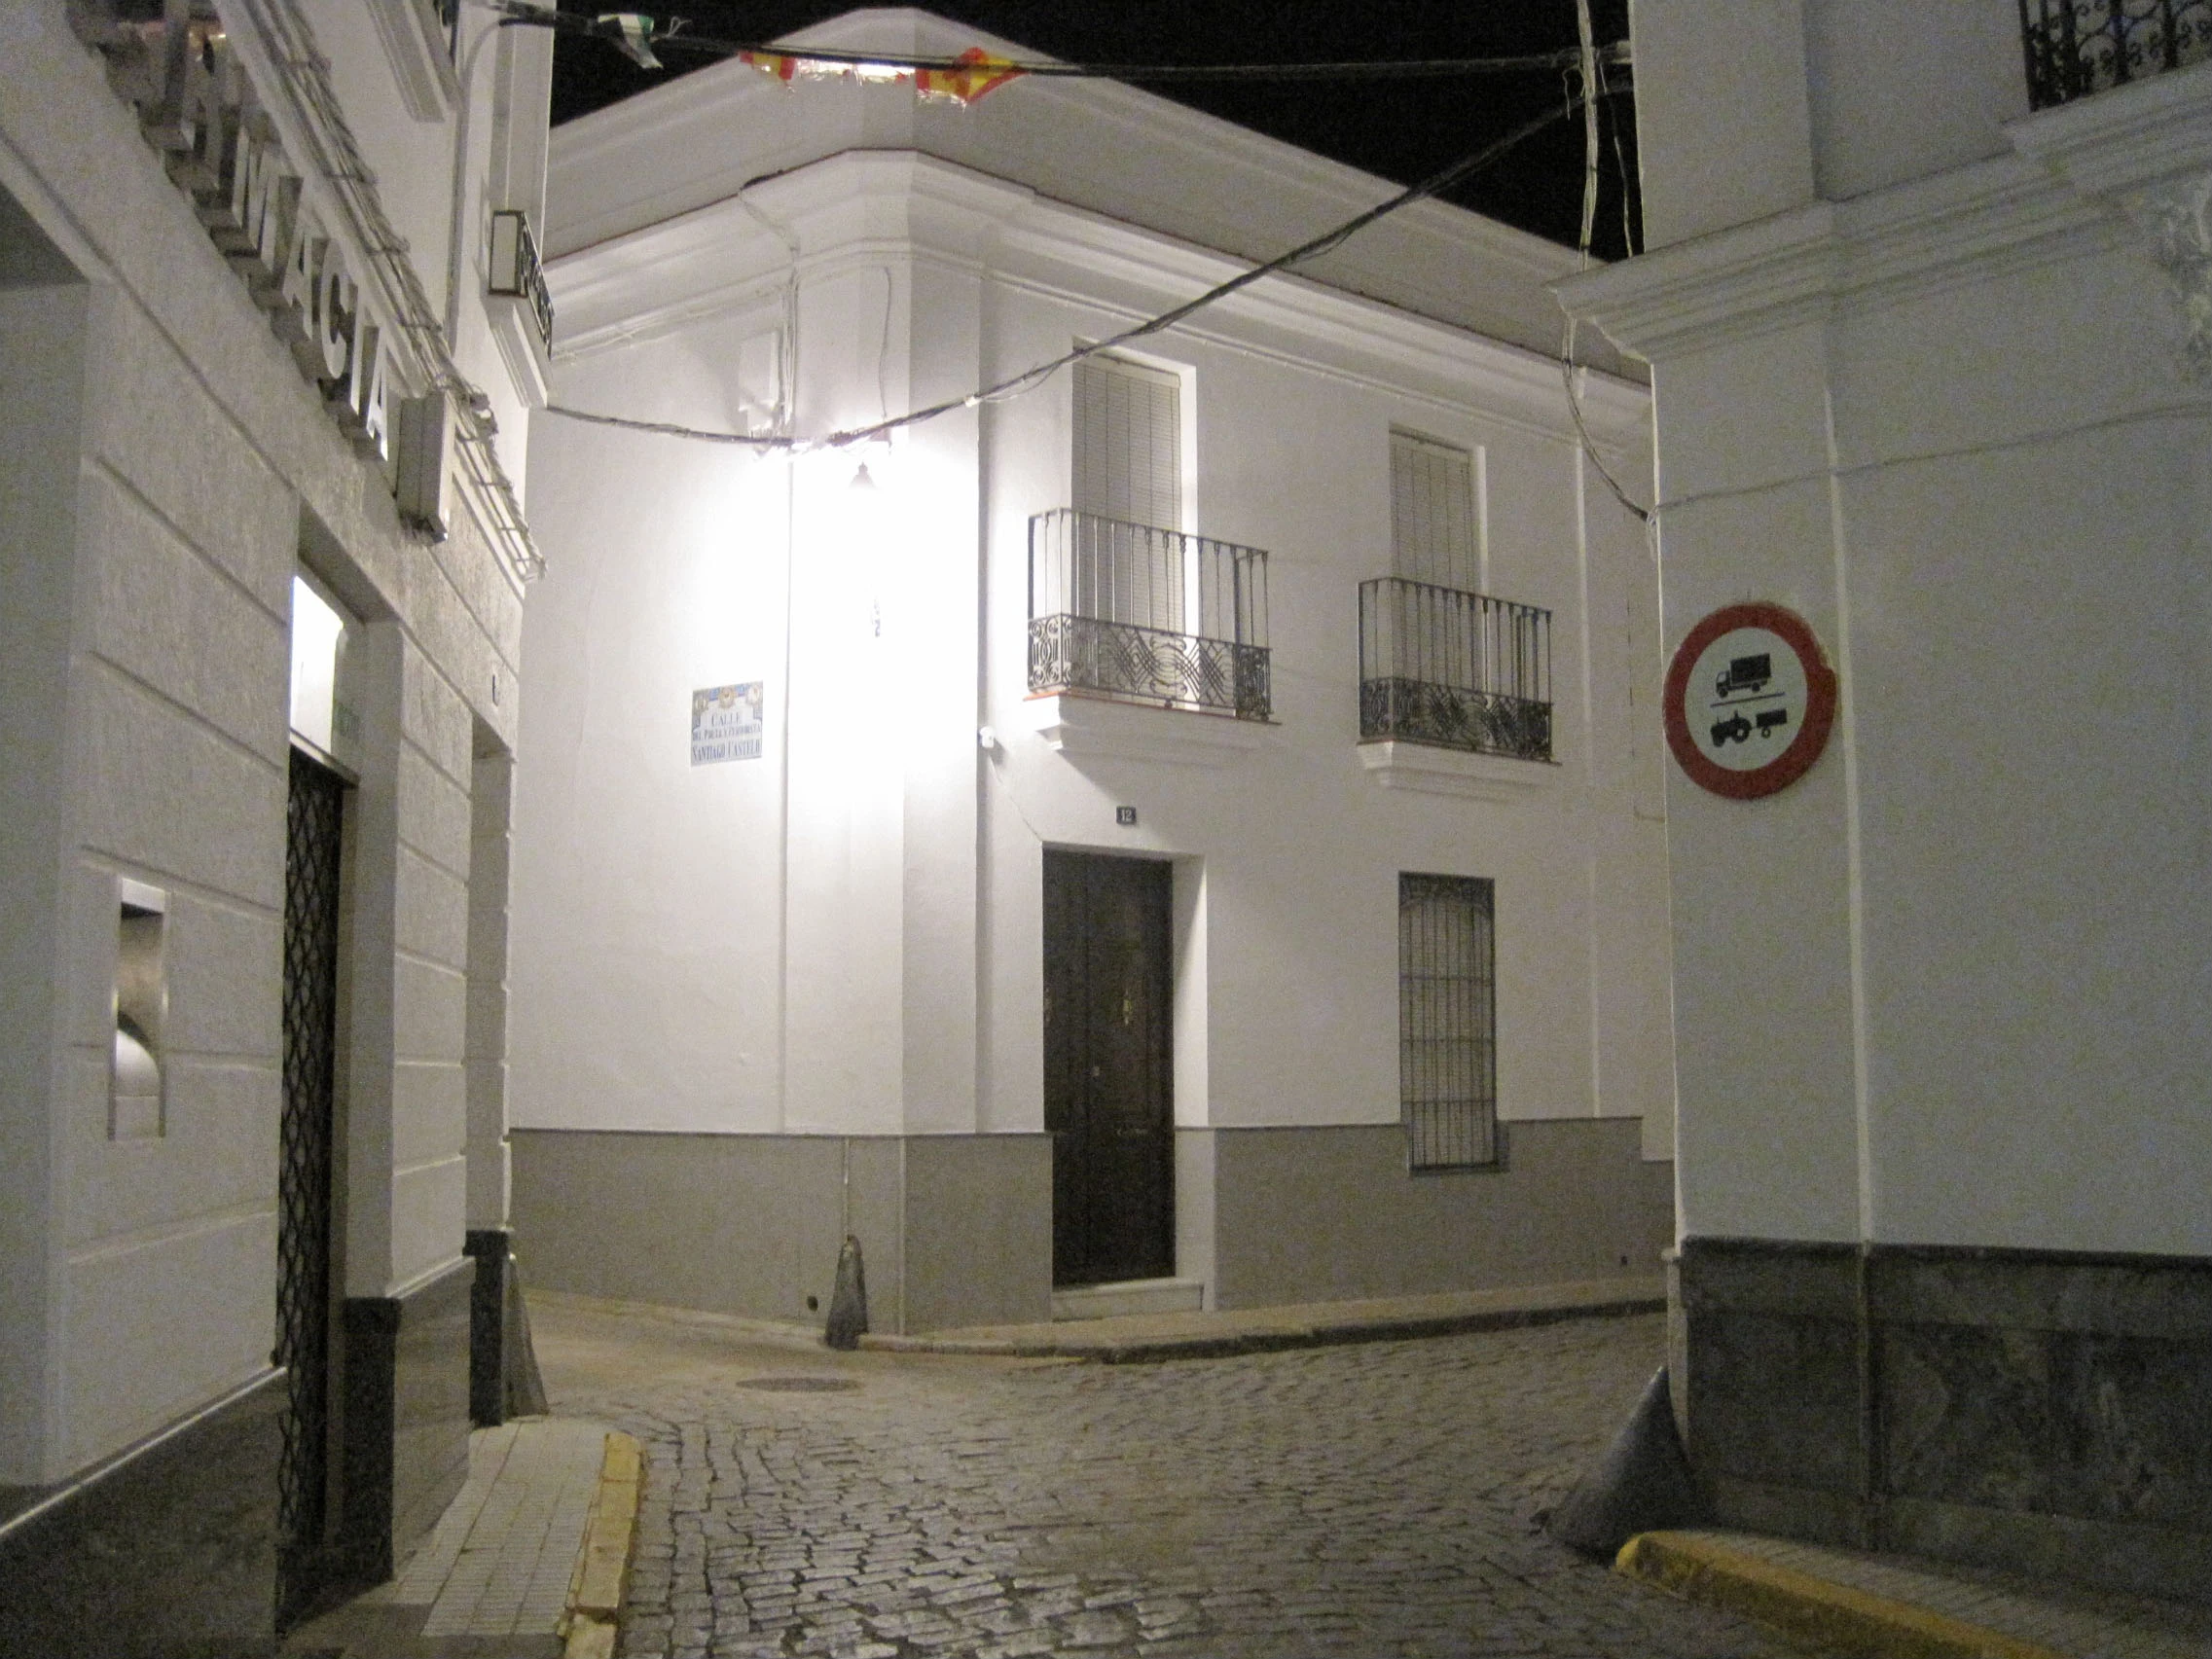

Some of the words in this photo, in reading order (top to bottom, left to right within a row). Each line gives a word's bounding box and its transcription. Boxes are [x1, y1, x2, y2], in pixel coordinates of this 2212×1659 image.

[102, 0, 389, 462] RMACIA
[711, 712, 740, 726] CALLE
[1121, 809, 1132, 822] 12
